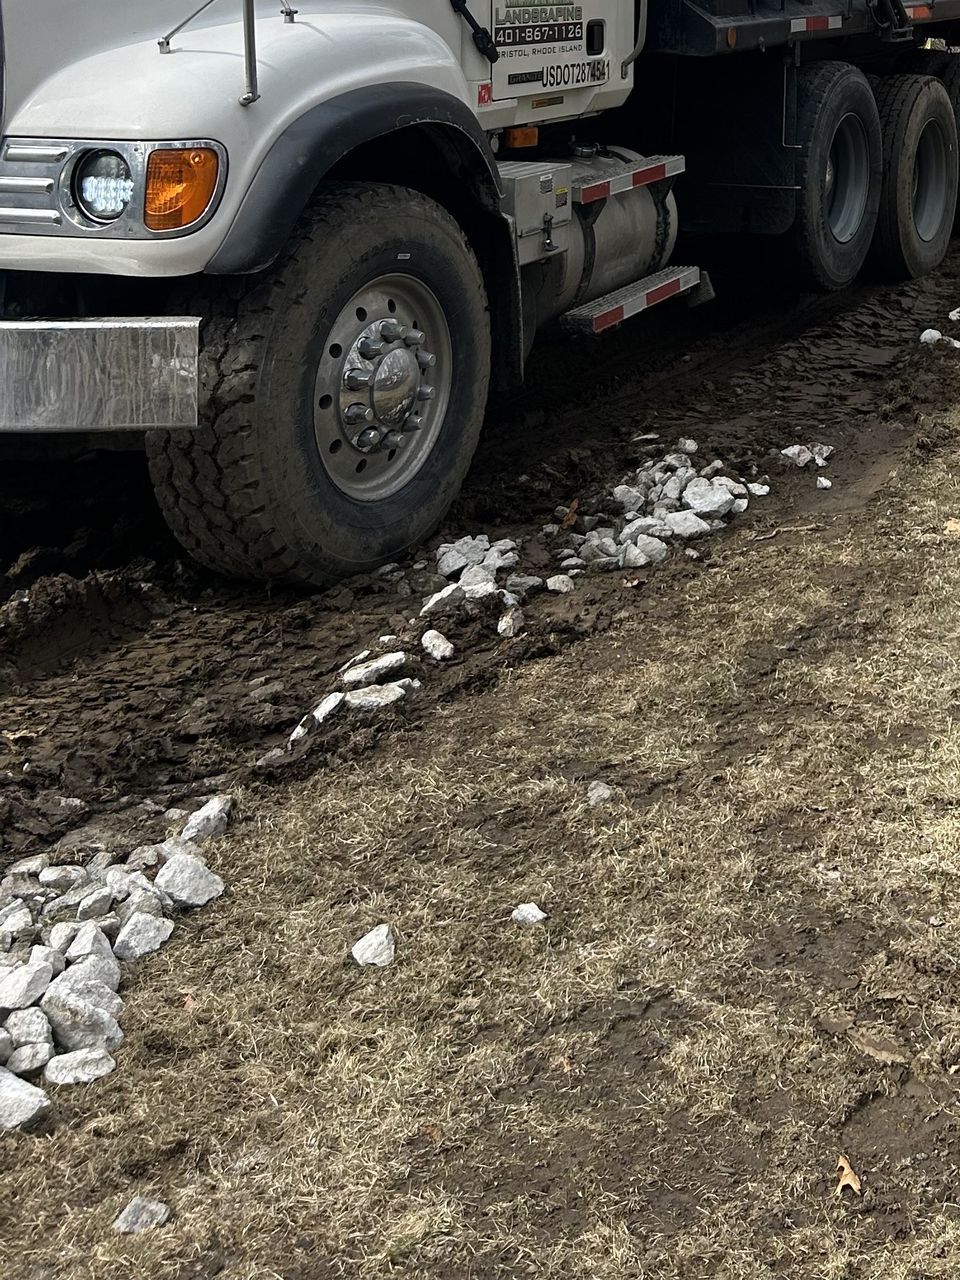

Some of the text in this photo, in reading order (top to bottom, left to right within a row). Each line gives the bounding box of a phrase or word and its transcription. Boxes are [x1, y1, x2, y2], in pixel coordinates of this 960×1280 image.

[495, 6, 582, 25] LANDSCAPING
[496, 25, 582, 43] 401-867-1126
[532, 46, 557, 56] RHODE
[559, 44, 583, 53] ISLAND
